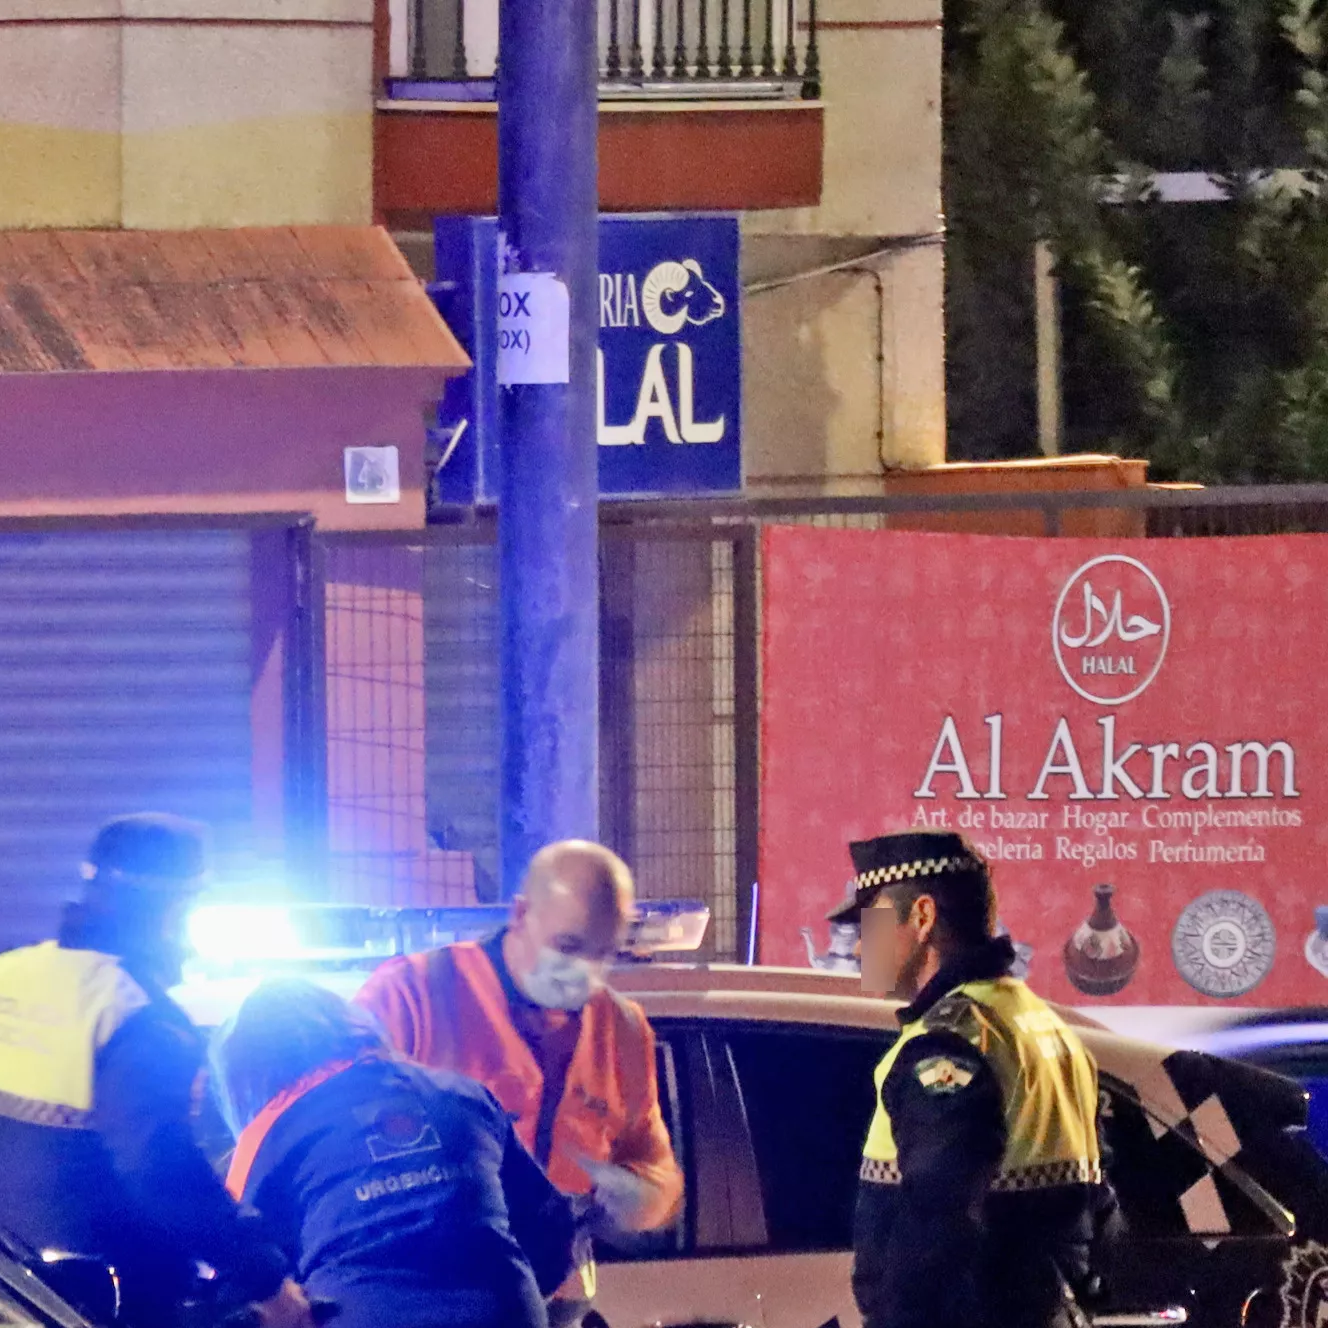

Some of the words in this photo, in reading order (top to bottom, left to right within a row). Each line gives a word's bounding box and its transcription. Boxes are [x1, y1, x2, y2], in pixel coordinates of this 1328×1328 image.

[1061, 580, 1162, 648] حلال
[1082, 655, 1138, 675] HALAL
[913, 713, 1007, 800] Al
[1027, 713, 1301, 801] Akram
[911, 804, 953, 828] Art.
[957, 804, 986, 829] de
[989, 804, 1050, 829] bazar
[1062, 804, 1130, 836] Hogar
[1141, 803, 1303, 836] Complementos
[1055, 836, 1138, 868] Regalos
[1149, 836, 1266, 864] Perfumería
